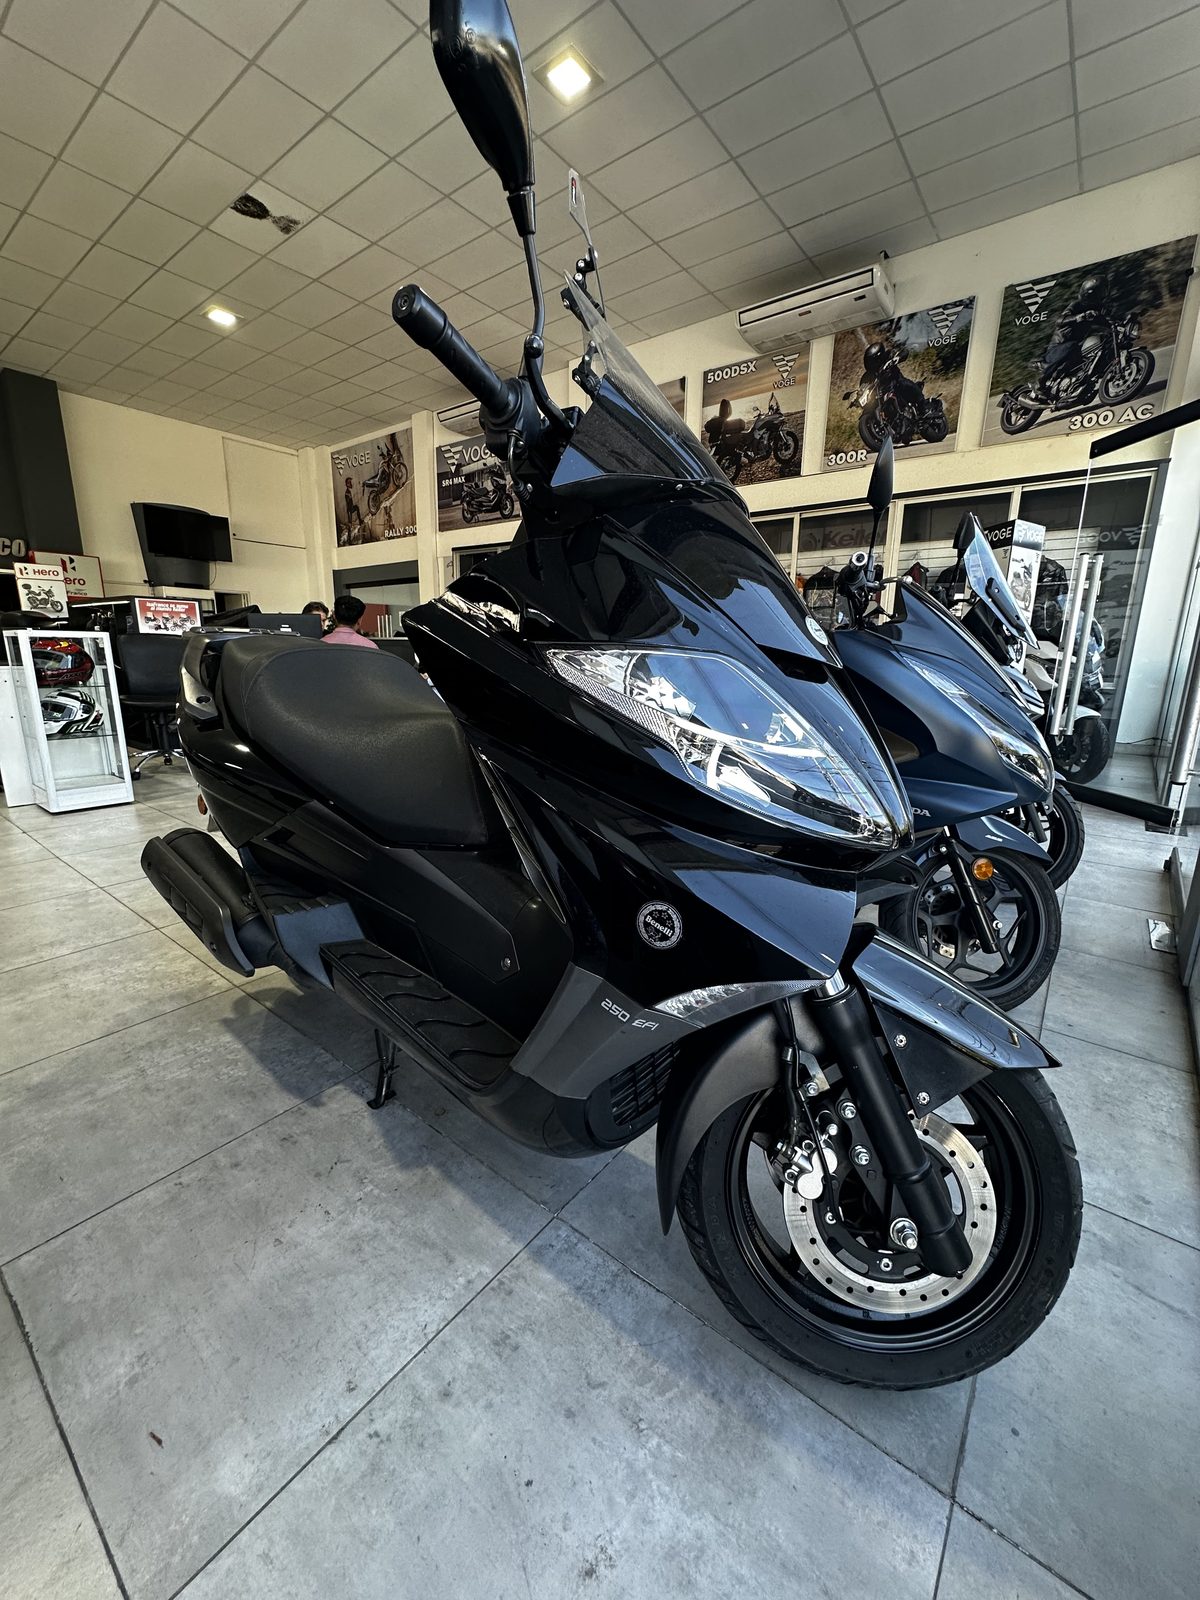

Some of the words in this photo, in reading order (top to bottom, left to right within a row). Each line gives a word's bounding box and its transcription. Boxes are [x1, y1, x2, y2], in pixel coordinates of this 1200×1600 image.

[1015, 311, 1048, 326] VOGE
[928, 335, 957, 347] VOGE
[707, 360, 757, 384] 500DSX
[773, 376, 796, 389] VOGE
[1069, 409, 1115, 431] 300
[1118, 404, 1154, 424] AC
[347, 451, 371, 468] VOGE
[463, 443, 496, 463] VOG
[827, 449, 868, 467] 300R
[442, 479, 453, 487] SR4
[454, 476, 466, 484] MAX
[384, 527, 404, 538] RALLY
[988, 526, 1013, 541] VOGE
[33, 568, 60, 577] Hero
[645, 914, 674, 938] Benelli
[601, 998, 631, 1022] 250
[632, 1019, 659, 1031] EFI
